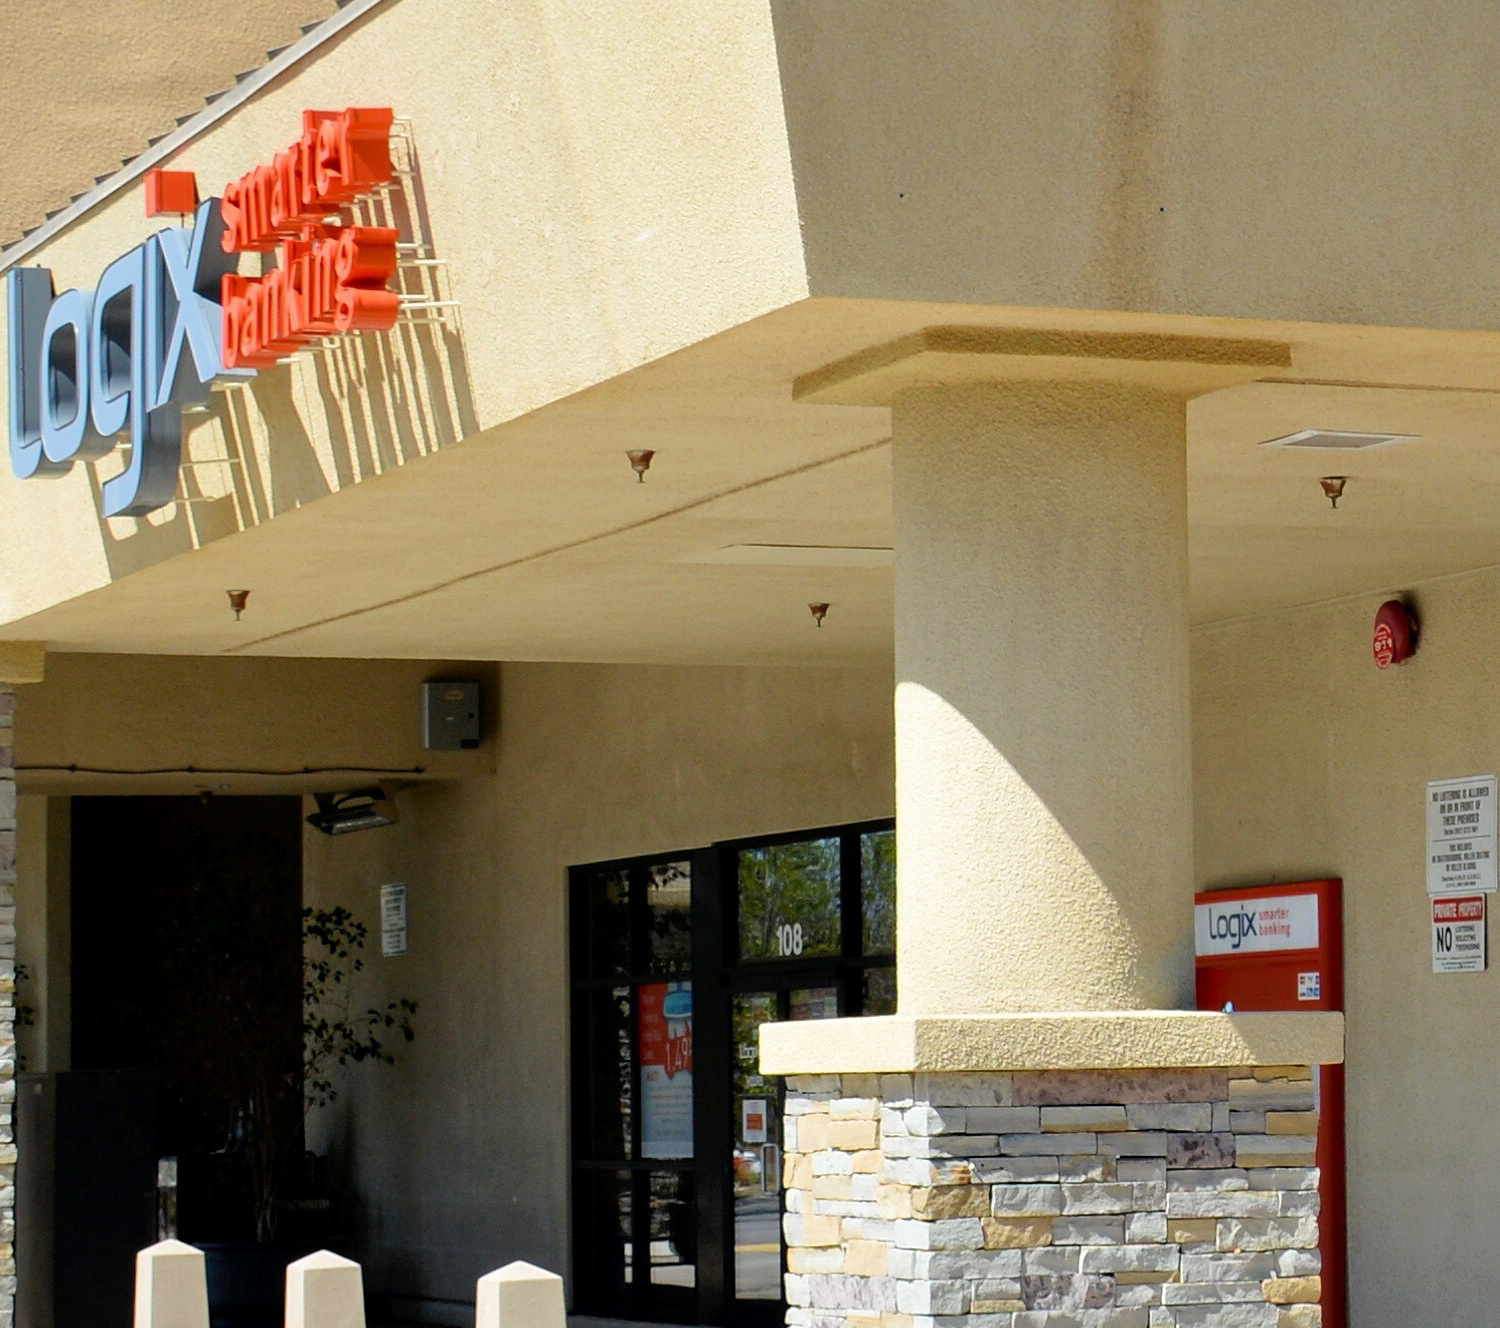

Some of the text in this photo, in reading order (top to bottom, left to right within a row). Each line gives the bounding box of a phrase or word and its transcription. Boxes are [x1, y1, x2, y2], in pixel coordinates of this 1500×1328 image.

[221, 107, 392, 252] smarter
[221, 225, 399, 369] banking
[1259, 907, 1290, 920] smarter
[1434, 901, 1482, 919] PRIVATE PROPERTY
[776, 923, 803, 957] 108
[1258, 923, 1291, 938] banking
[1436, 926, 1453, 953] NO
